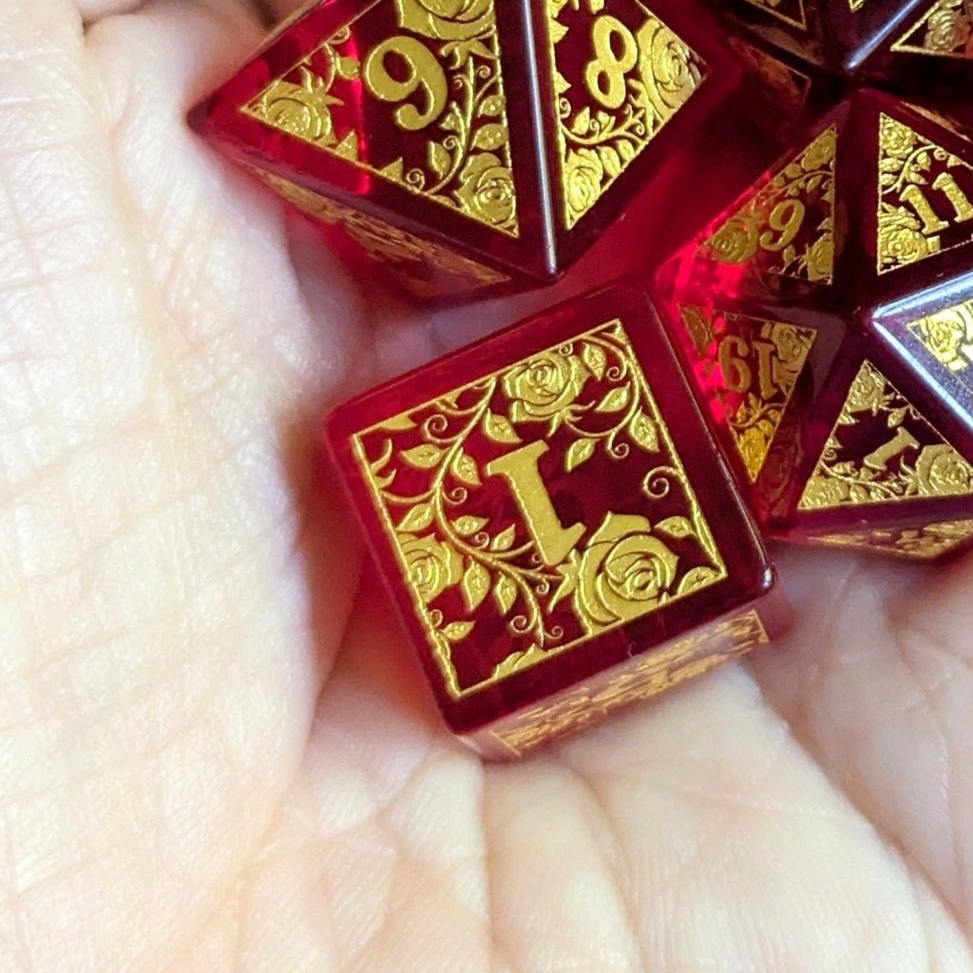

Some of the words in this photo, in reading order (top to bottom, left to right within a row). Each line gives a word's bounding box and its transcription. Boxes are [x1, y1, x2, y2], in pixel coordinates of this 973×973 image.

[586, 15, 638, 110] 8
[863, 426, 920, 471] 1
[485, 440, 587, 566] 1
